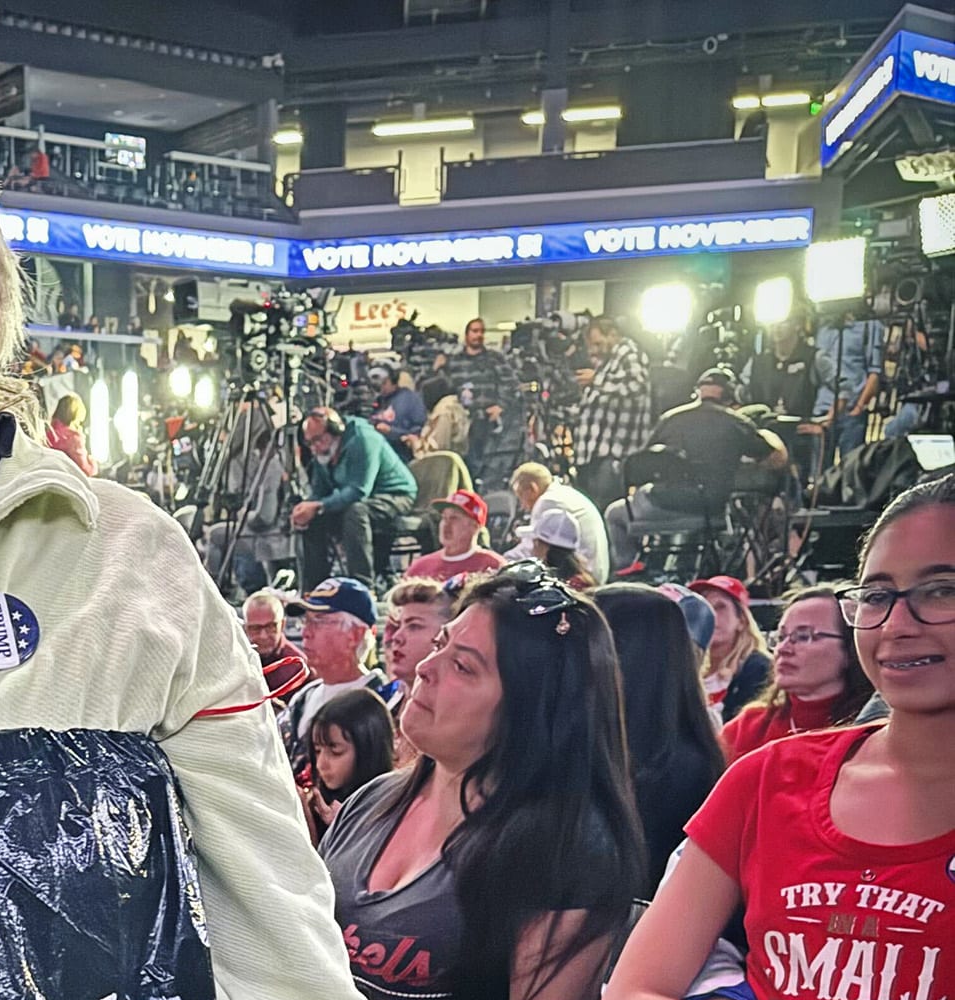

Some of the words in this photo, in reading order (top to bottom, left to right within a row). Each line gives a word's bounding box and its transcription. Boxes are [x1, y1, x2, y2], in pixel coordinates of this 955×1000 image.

[82, 223, 141, 253] VOTE
[142, 229, 253, 265] NOVEMBER
[302, 245, 371, 271] VOTE
[372, 236, 515, 268] NOVEMBER
[583, 226, 656, 254] VOTE
[658, 217, 810, 249] NOVEMBER
[354, 298, 407, 321] Lee's
[780, 882, 846, 909] TRY
[855, 884, 945, 923] THAT
